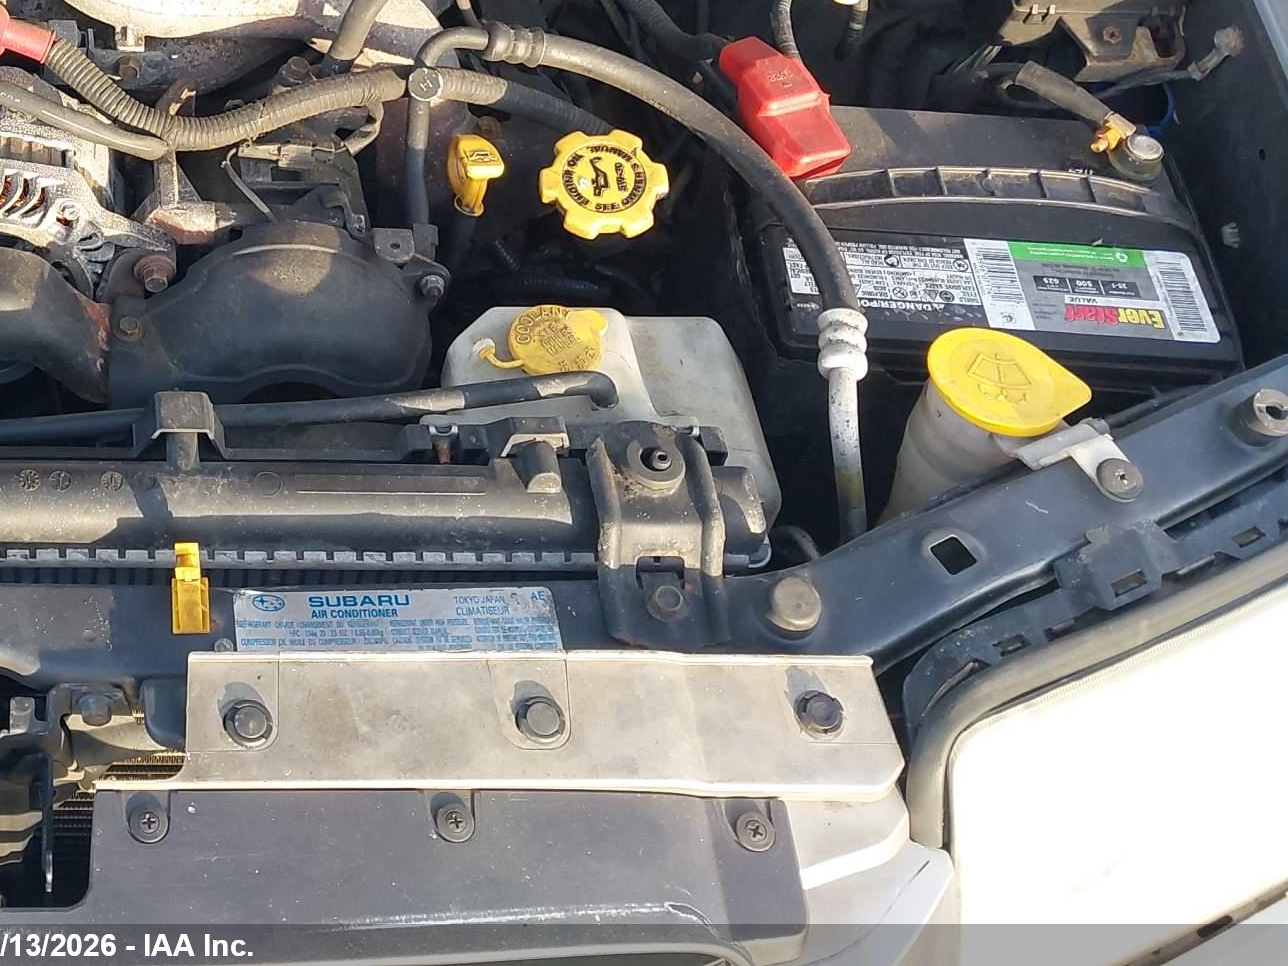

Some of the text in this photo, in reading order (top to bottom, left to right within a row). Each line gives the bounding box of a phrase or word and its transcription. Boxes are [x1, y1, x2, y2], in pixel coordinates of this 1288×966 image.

[586, 146, 633, 163] MANUAL
[563, 153, 590, 206] ENGINE OIL
[595, 202, 619, 211] SEE
[1068, 296, 1098, 304] VALUE
[1064, 304, 1166, 330] EverStart
[515, 306, 571, 344] COOLANT
[307, 593, 410, 608] SUBARU
[454, 595, 507, 605] TOKYO JAPAN
[311, 608, 399, 620] AIR CONDITIONER
[456, 605, 511, 617] CLIMATISEUR
